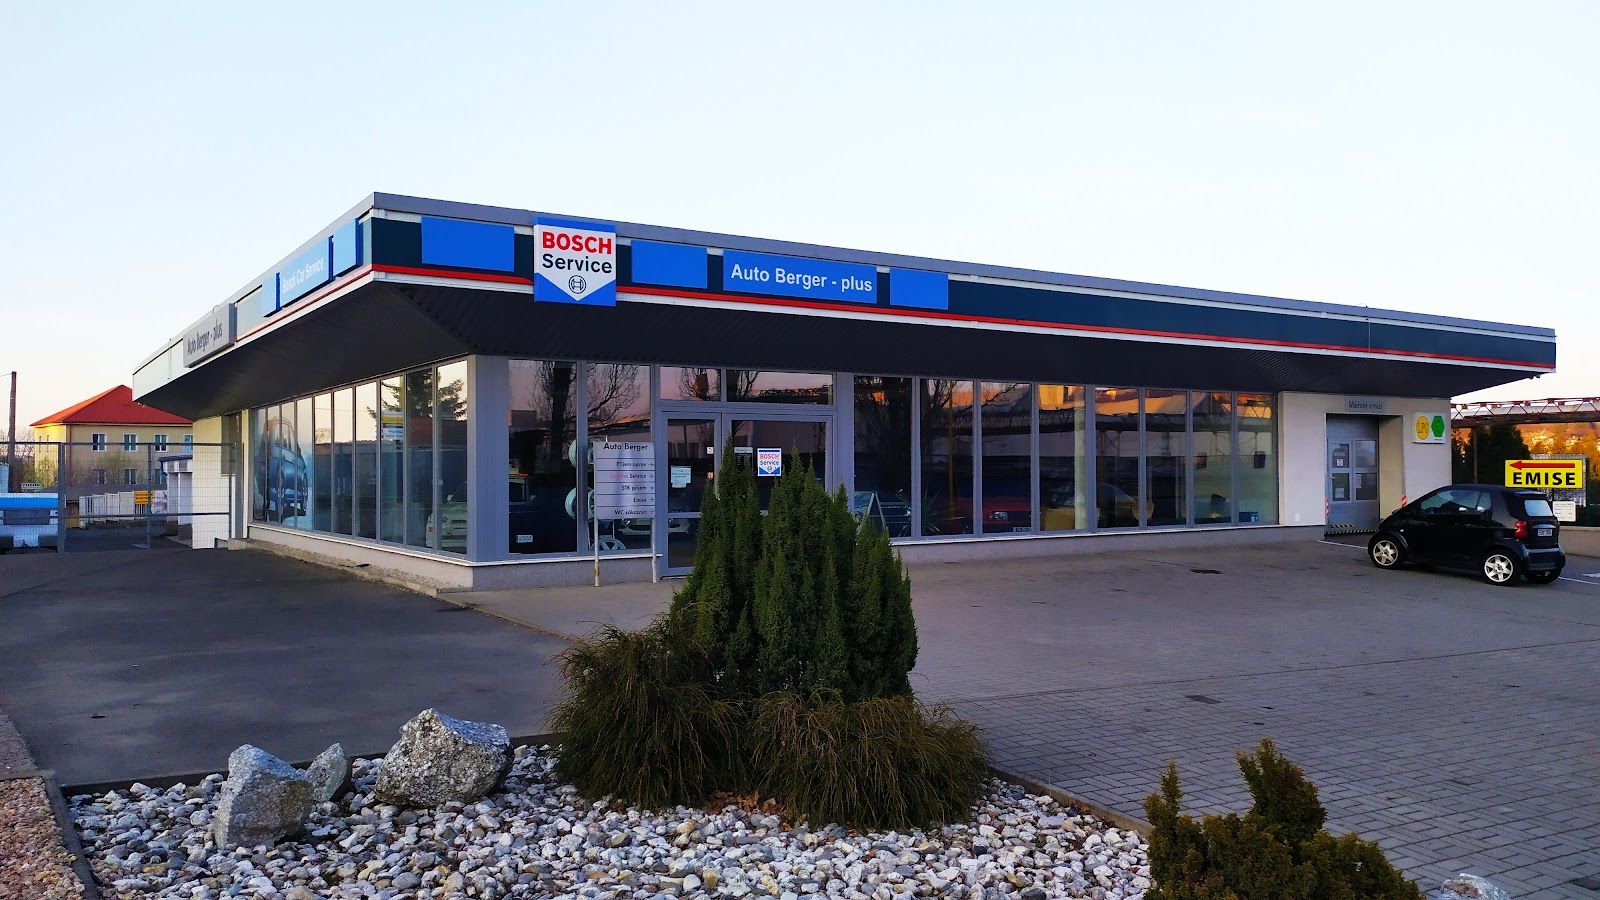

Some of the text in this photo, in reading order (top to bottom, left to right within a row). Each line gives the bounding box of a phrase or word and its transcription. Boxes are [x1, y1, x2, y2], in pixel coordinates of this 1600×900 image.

[542, 231, 612, 255] BOSCH
[306, 258, 325, 279] Service
[542, 253, 613, 274] Service
[730, 263, 770, 282] Auto
[775, 267, 827, 290] Berger
[841, 275, 873, 293] plus
[603, 442, 648, 452] Auto Berger
[1513, 472, 1576, 486] EMISE
